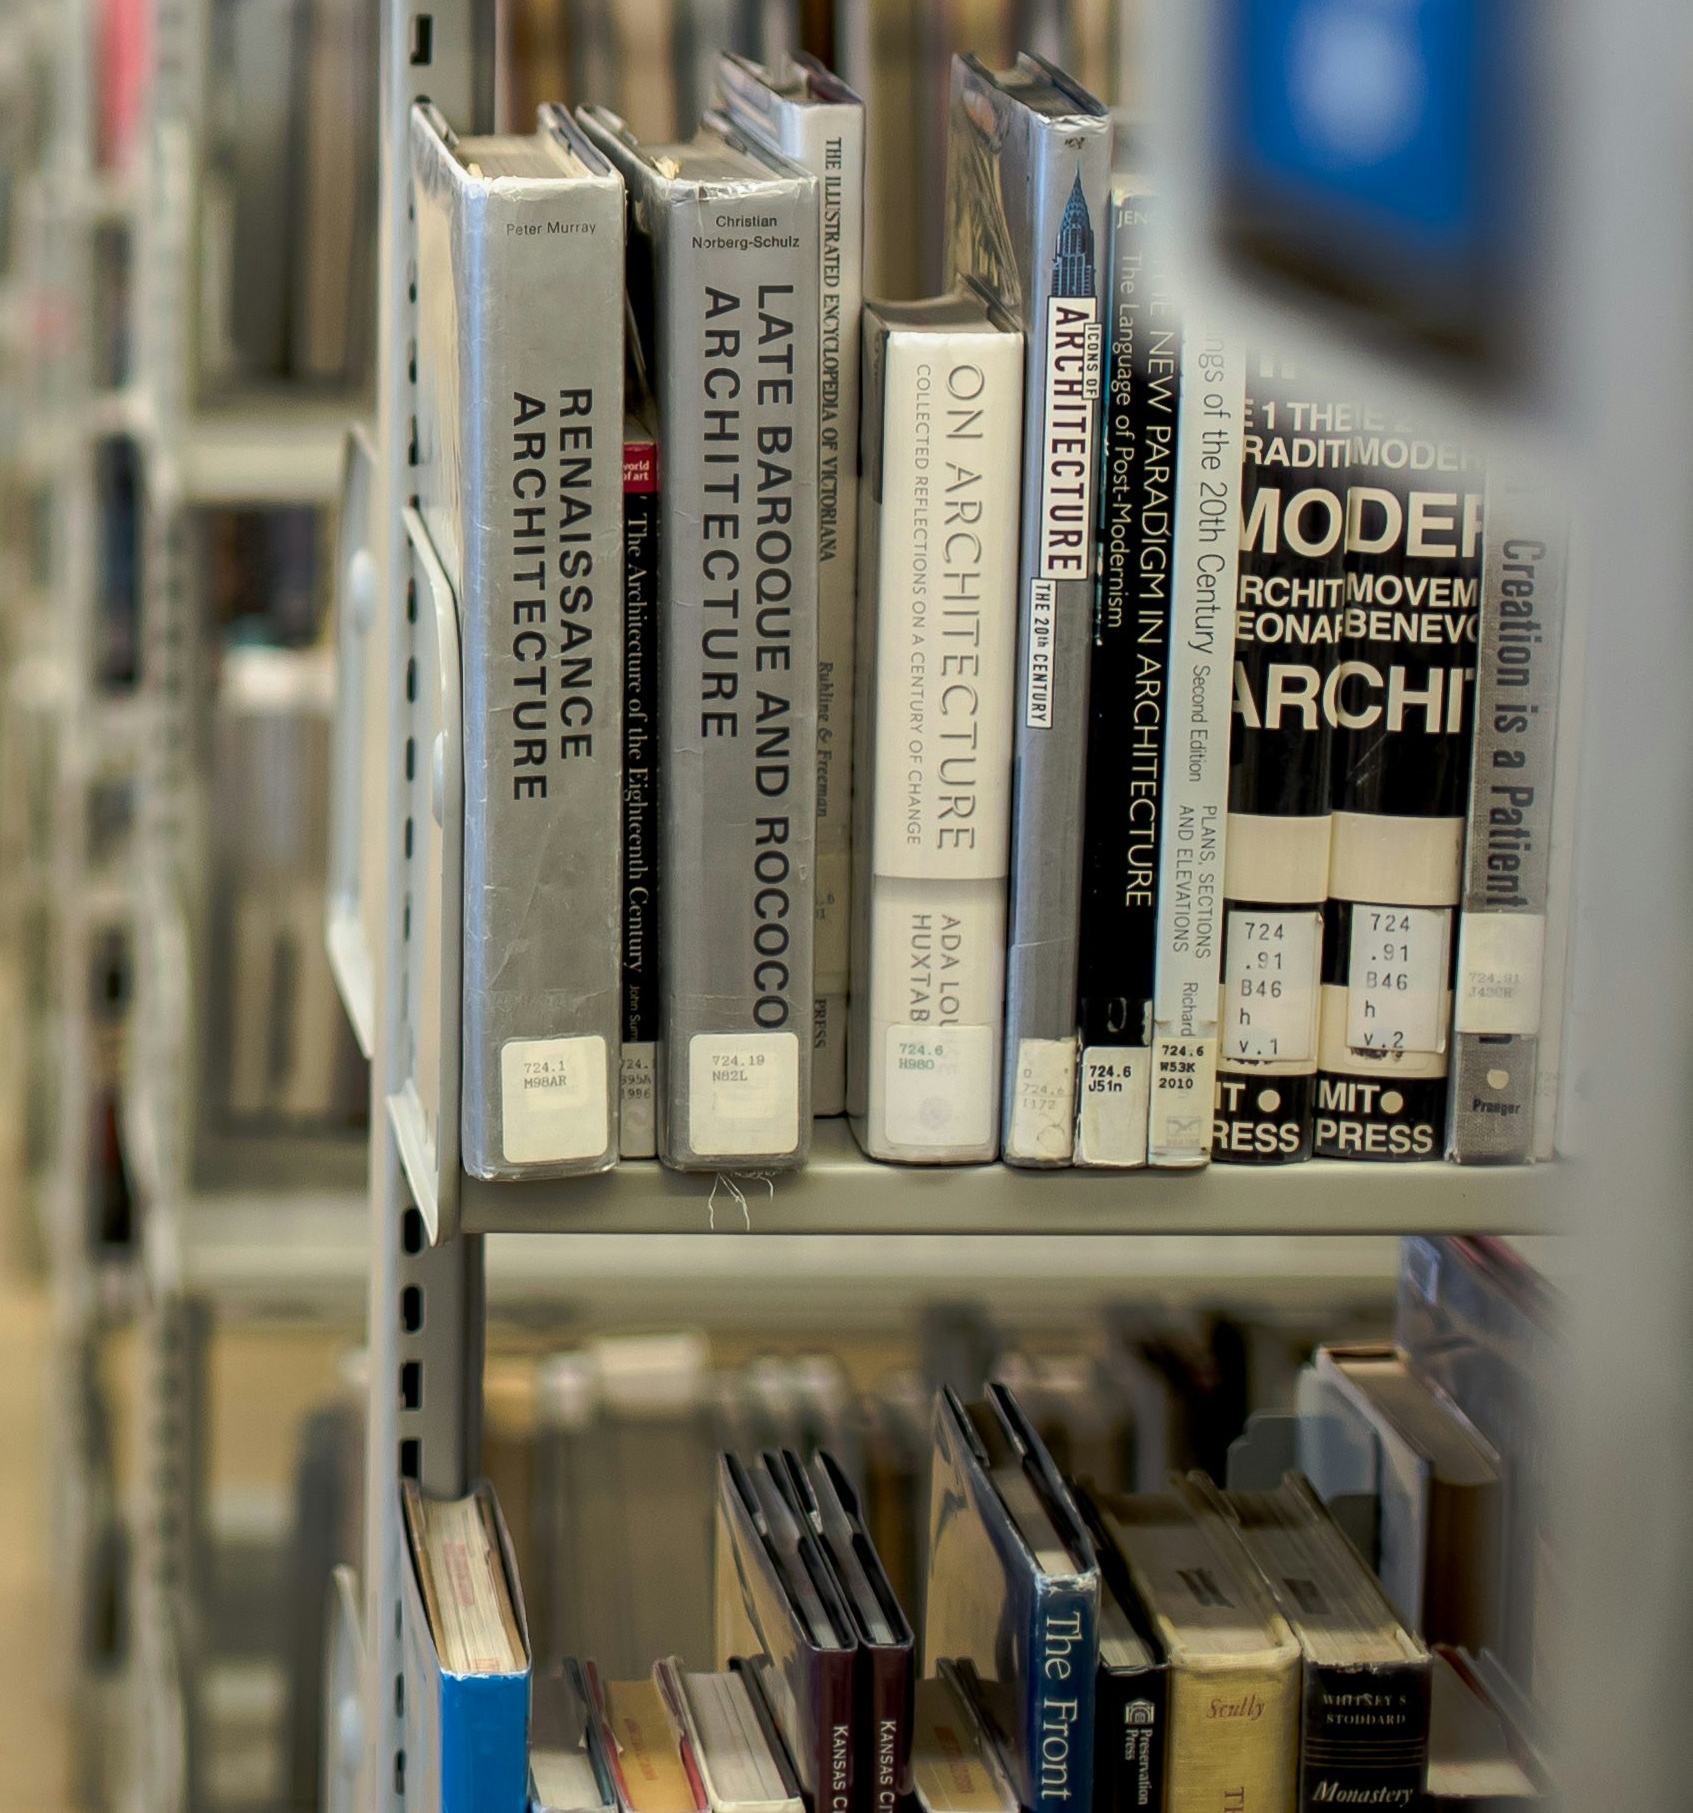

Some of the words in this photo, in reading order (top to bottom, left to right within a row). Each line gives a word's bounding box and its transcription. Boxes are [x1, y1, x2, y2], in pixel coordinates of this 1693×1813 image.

[826, 137, 842, 170] THE
[506, 222, 543, 236] Peter
[547, 220, 597, 236] Murray
[716, 215, 778, 228] Christian
[824, 178, 842, 288] ILLUSTRATED
[692, 235, 800, 251] Norberg-Schulz
[1120, 253, 1142, 294] The
[757, 284, 794, 405] LATE
[822, 293, 841, 420] ENCYCLOPEDIA
[1087, 326, 1099, 372] ICONS
[1111, 304, 1139, 405] Language
[1086, 379, 1098, 396] OF
[1147, 330, 1175, 412] NEW
[916, 364, 931, 474] COLLECTED
[948, 364, 985, 440] ON
[1203, 393, 1231, 418] of
[1286, 402, 1352, 432] THE
[821, 427, 838, 450] OF
[1048, 306, 1089, 570] ARCHITECTURE
[1114, 415, 1135, 440] of
[1201, 429, 1229, 470] the
[701, 287, 741, 738] ARCHITECTURE
[819, 455, 838, 562] VICTORIANA
[1140, 426, 1172, 602] PARADIGM
[1200, 482, 1228, 541] 20th
[628, 514, 648, 556] The
[755, 427, 793, 672] BAROQUE
[913, 477, 929, 594] REFLECTIONS
[1108, 446, 1134, 628] Post-Modernism
[559, 388, 593, 760] RENAISSANCE
[513, 392, 547, 800] ARCHITECTURE
[912, 601, 926, 624] ON
[1034, 584, 1051, 611] THE
[1188, 554, 1226, 654] Century
[1496, 540, 1546, 687] Creation
[628, 563, 648, 693] Architecture
[911, 627, 925, 645] A
[1033, 618, 1049, 647] 20th
[1137, 610, 1164, 644] IN
[937, 464, 983, 850] ARCHITECTURE
[909, 652, 926, 733] CENTURY
[1031, 654, 1048, 721] CENTURY
[1192, 665, 1211, 724] Second
[628, 700, 648, 720] of
[1494, 704, 1539, 735] is
[628, 726, 647, 759] the
[755, 691, 791, 798] AND
[908, 741, 924, 764] OF
[1188, 729, 1209, 782] Edition
[1492, 750, 1526, 769] a
[816, 749, 831, 818] Freeman
[1126, 654, 1162, 906] ARCHITECTURE
[623, 767, 648, 880] Eighteenth
[906, 771, 922, 845] CHANGE
[1179, 805, 1195, 841] AND
[1200, 805, 1218, 864] PLANS,
[1486, 787, 1534, 907] Patient
[1173, 847, 1193, 953] ELEVATIONS
[1195, 871, 1215, 959] SECTIONS
[623, 887, 649, 974] Century
[752, 815, 790, 1028] ROCOCO
[940, 913, 961, 970] ADA
[1244, 922, 1285, 940] 724
[1370, 914, 1411, 932] 724
[909, 914, 932, 1022] HUXTAB
[1246, 952, 1283, 970] .91
[1371, 944, 1409, 962] .91
[629, 984, 639, 1011] John
[1241, 980, 1282, 998] B46
[1366, 972, 1408, 990] B46
[1180, 981, 1199, 1037] Richard
[899, 1043, 943, 1056] 724.6
[1162, 1045, 1204, 1057] 724.6
[1239, 1038, 1279, 1054] v.1
[1364, 1031, 1404, 1049] v.2
[524, 1061, 566, 1074] 724.1
[712, 1055, 765, 1068] 724.19
[1090, 1065, 1131, 1078] 724.6
[1088, 1081, 1123, 1092] J51n
[1159, 1078, 1193, 1090] 2010
[1318, 1080, 1381, 1113] MIT
[1473, 1098, 1521, 1116] Praeger
[1212, 1122, 1300, 1153] RESS
[1317, 1120, 1433, 1154] PRESS
[1044, 1612, 1082, 1680] The
[1206, 1692, 1265, 1721] Scully
[1323, 1693, 1392, 1706] WHITNEY
[1326, 1714, 1406, 1726] STODDARD
[832, 1725, 849, 1790] KANSAS
[880, 1720, 897, 1785] KANSAS
[1041, 1697, 1078, 1801] Front
[1125, 1729, 1139, 1761] Press
[1138, 1729, 1153, 1805] Preservation
[1313, 1781, 1414, 1808] Monastery
